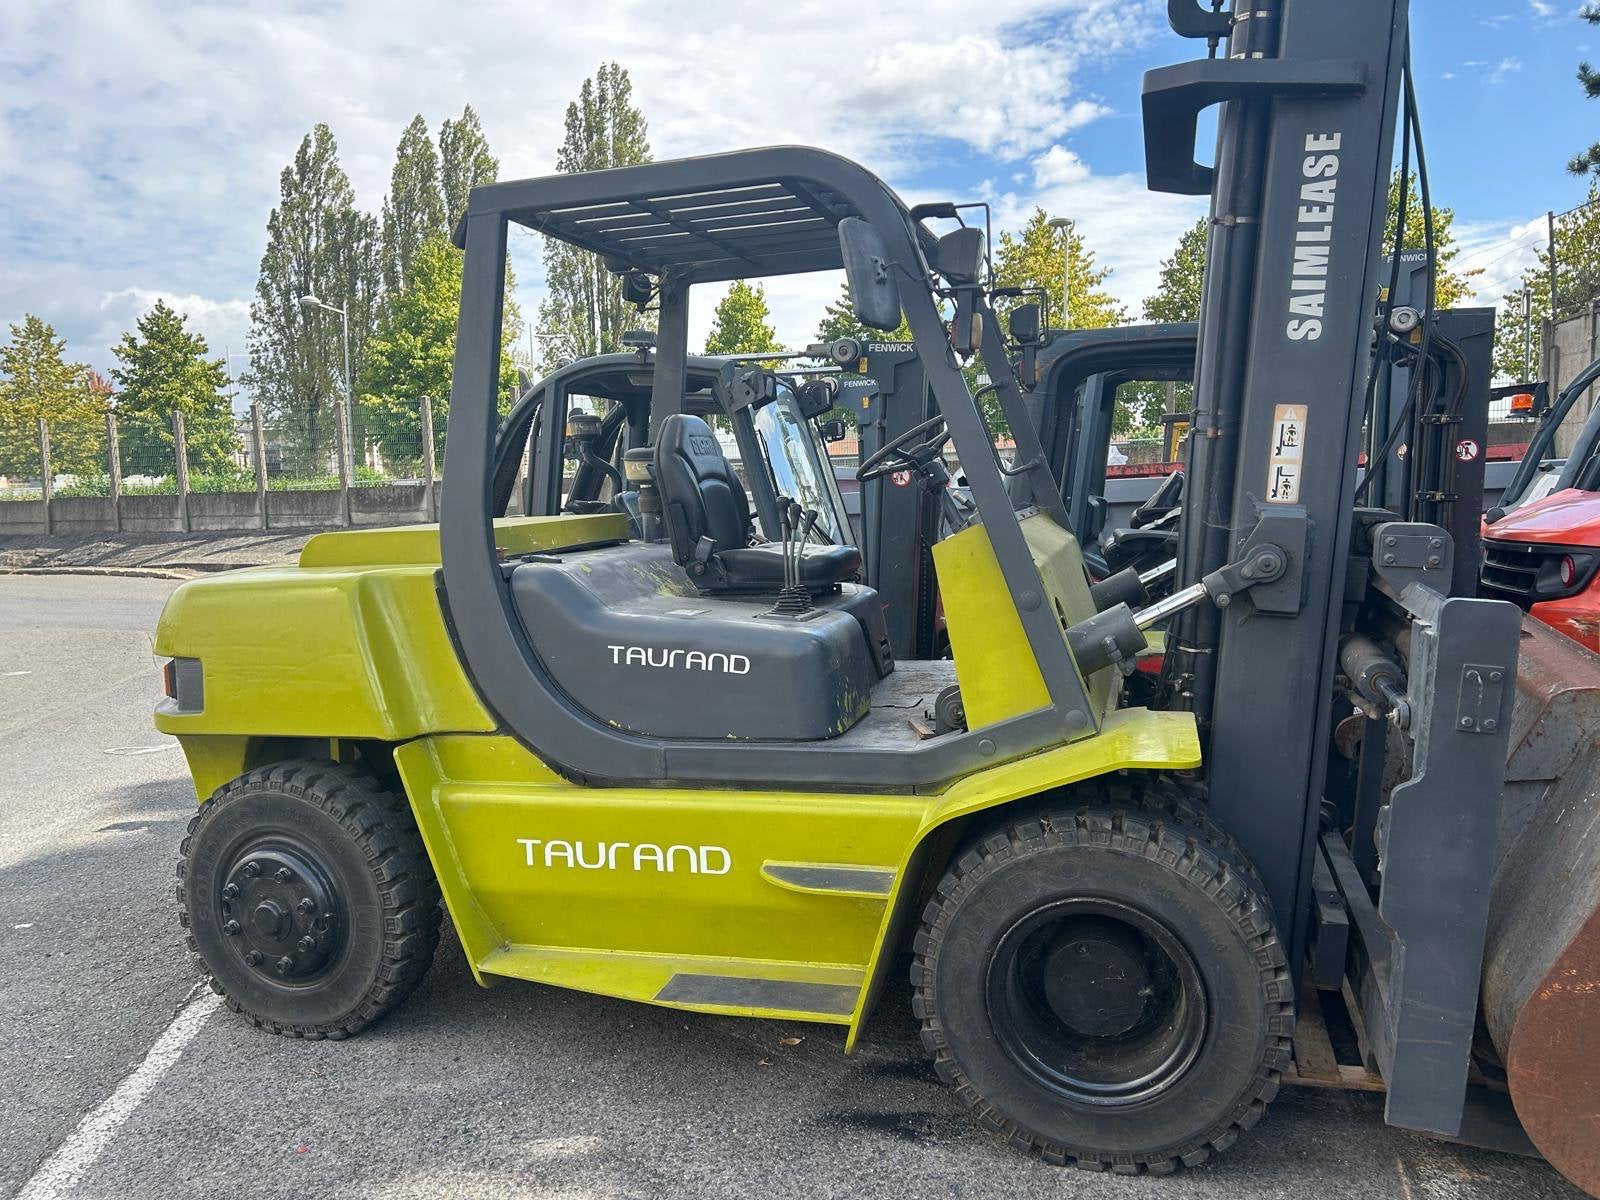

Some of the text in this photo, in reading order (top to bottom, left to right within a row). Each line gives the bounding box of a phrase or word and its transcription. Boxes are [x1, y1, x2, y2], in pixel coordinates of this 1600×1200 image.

[1286, 132, 1342, 341] SAIMLEASE
[868, 343, 913, 352] FENWICK
[843, 379, 877, 388] FENWICK
[607, 644, 751, 675] TAURAND
[516, 838, 732, 875] TAURAND
